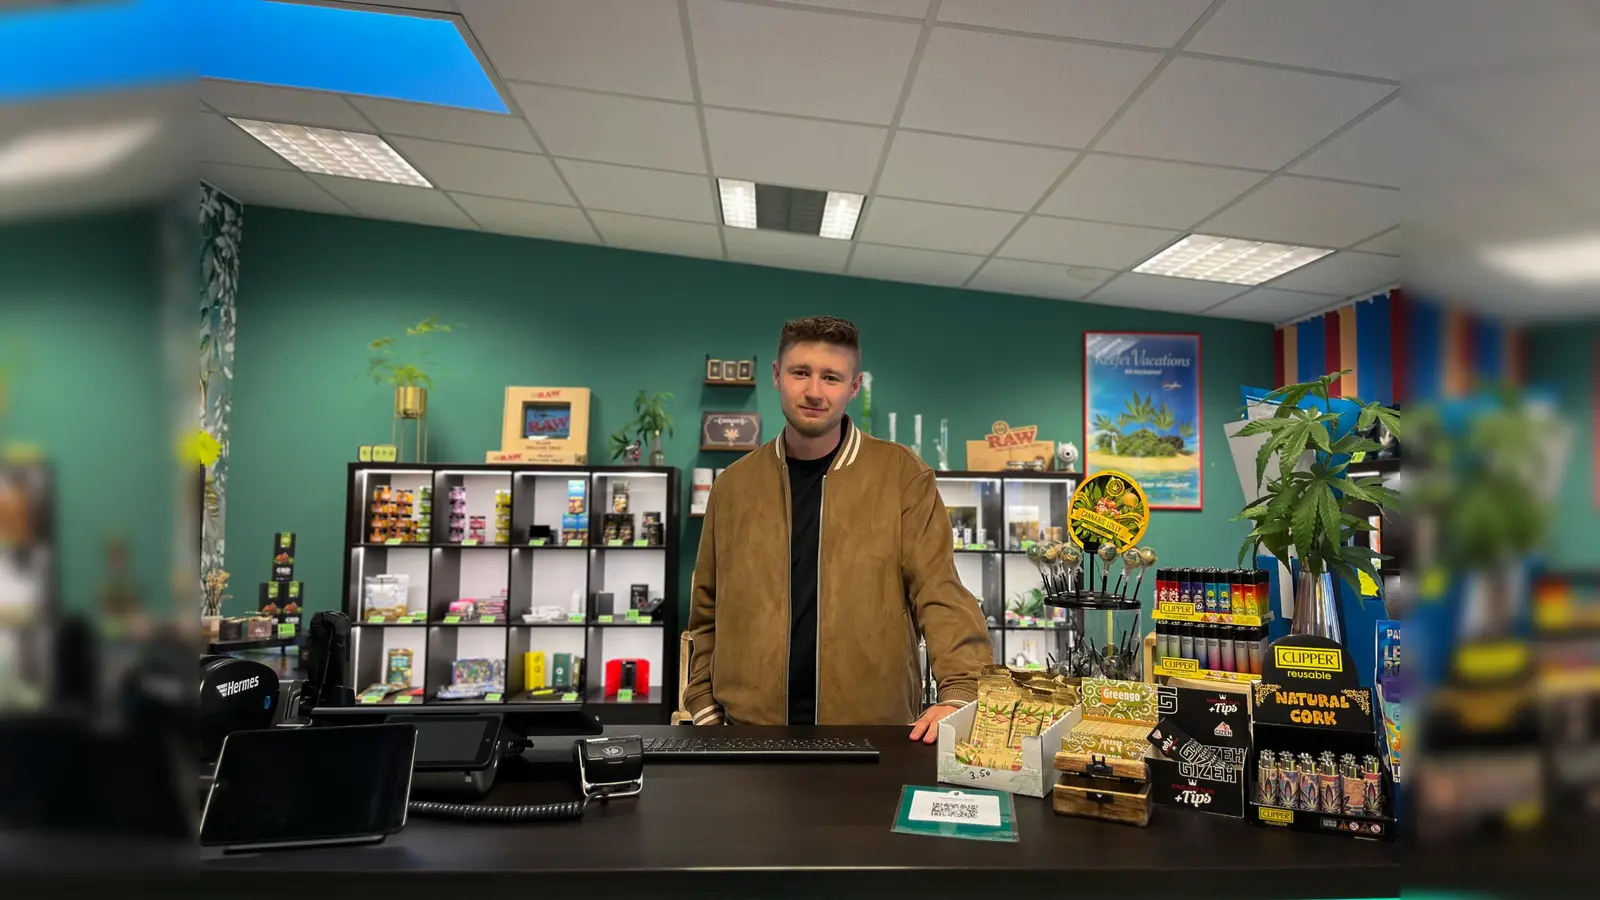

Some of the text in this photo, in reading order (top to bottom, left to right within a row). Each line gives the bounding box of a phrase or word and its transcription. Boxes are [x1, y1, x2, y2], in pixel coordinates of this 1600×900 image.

[1132, 348, 1191, 367] Vacations
[536, 390, 561, 399] RAW
[527, 416, 569, 433] RAW
[986, 430, 1036, 449] RAW
[500, 453, 522, 461] RAW
[1080, 510, 1106, 525] CANNABIS
[1106, 519, 1123, 533] LOLLY
[1163, 604, 1191, 613] CLIPPER
[1164, 660, 1194, 670] CLIPPER
[1282, 651, 1334, 666] CLIPPER
[1287, 670, 1332, 680] reusable
[227, 675, 259, 696] Hermes
[1103, 687, 1141, 702] Greengo
[1275, 691, 1350, 709] NATURAL
[1290, 709, 1337, 726] CORK
[969, 769, 991, 780] 3.50
[1178, 760, 1237, 784] GIZEH
[1262, 810, 1290, 820] CLIPPER
